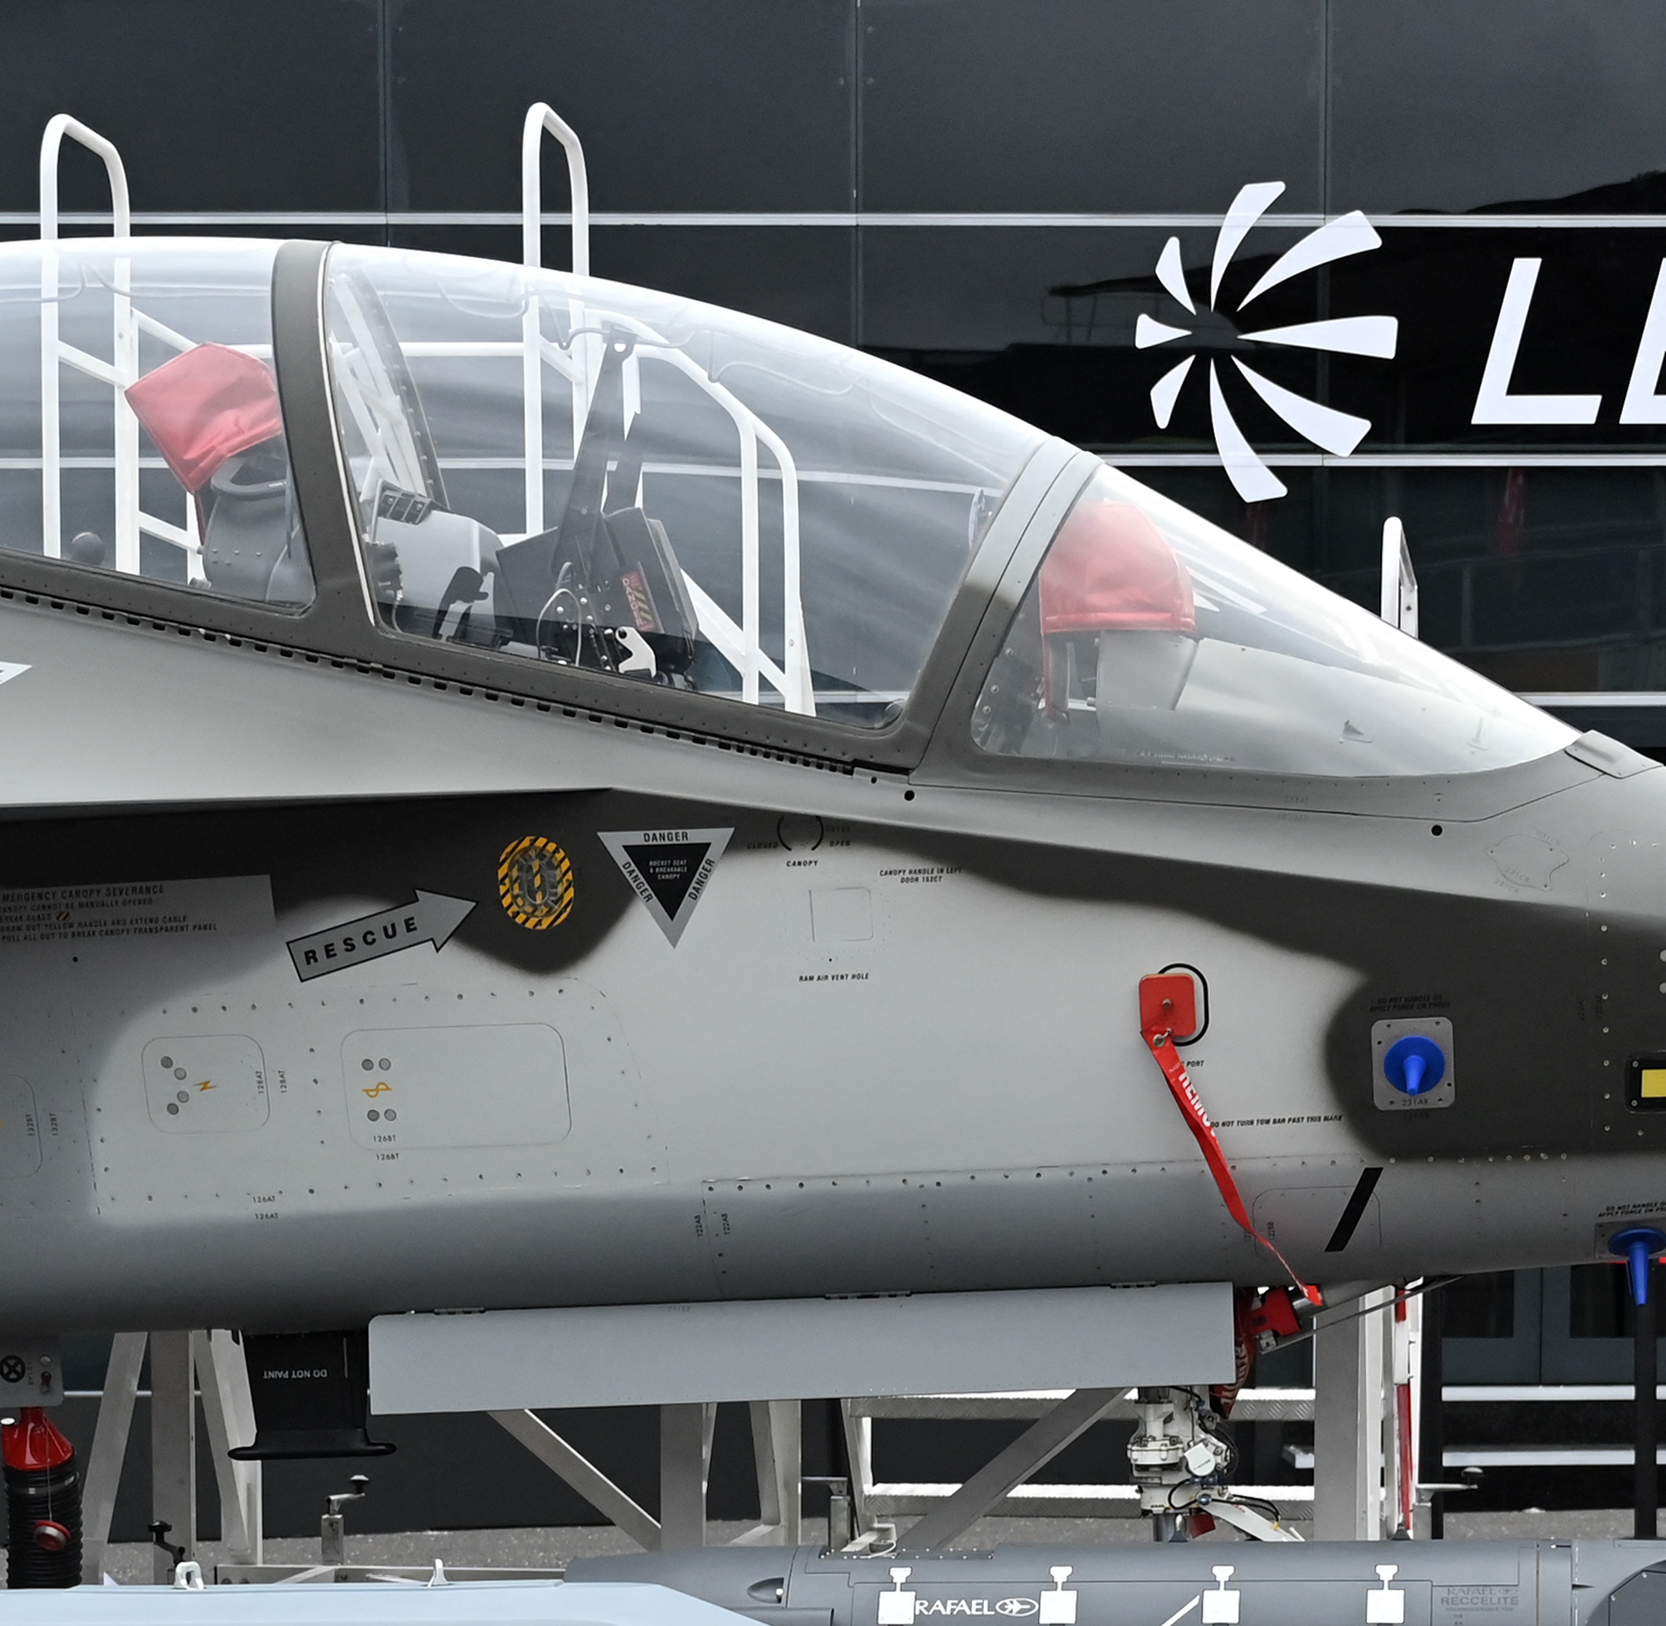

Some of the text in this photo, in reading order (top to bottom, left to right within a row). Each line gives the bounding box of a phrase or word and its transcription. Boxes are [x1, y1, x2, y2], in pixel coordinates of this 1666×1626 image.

[643, 831, 689, 843] DANGER
[688, 858, 715, 901] DANGER
[879, 868, 906, 877] CANOPY
[621, 861, 653, 903] DANGER
[60, 888, 102, 900] CANOPY
[105, 885, 164, 898] SEVERANCE
[98, 928, 130, 938] CANOPY
[133, 924, 190, 936] TRANSPARENT
[192, 922, 217, 932] PANEL
[304, 916, 418, 966] RESCUE
[263, 1369, 328, 1379] DO NOT PAINT
[915, 1599, 995, 1616] RAFAEL
[1440, 1596, 1519, 1606] RECCELITE
